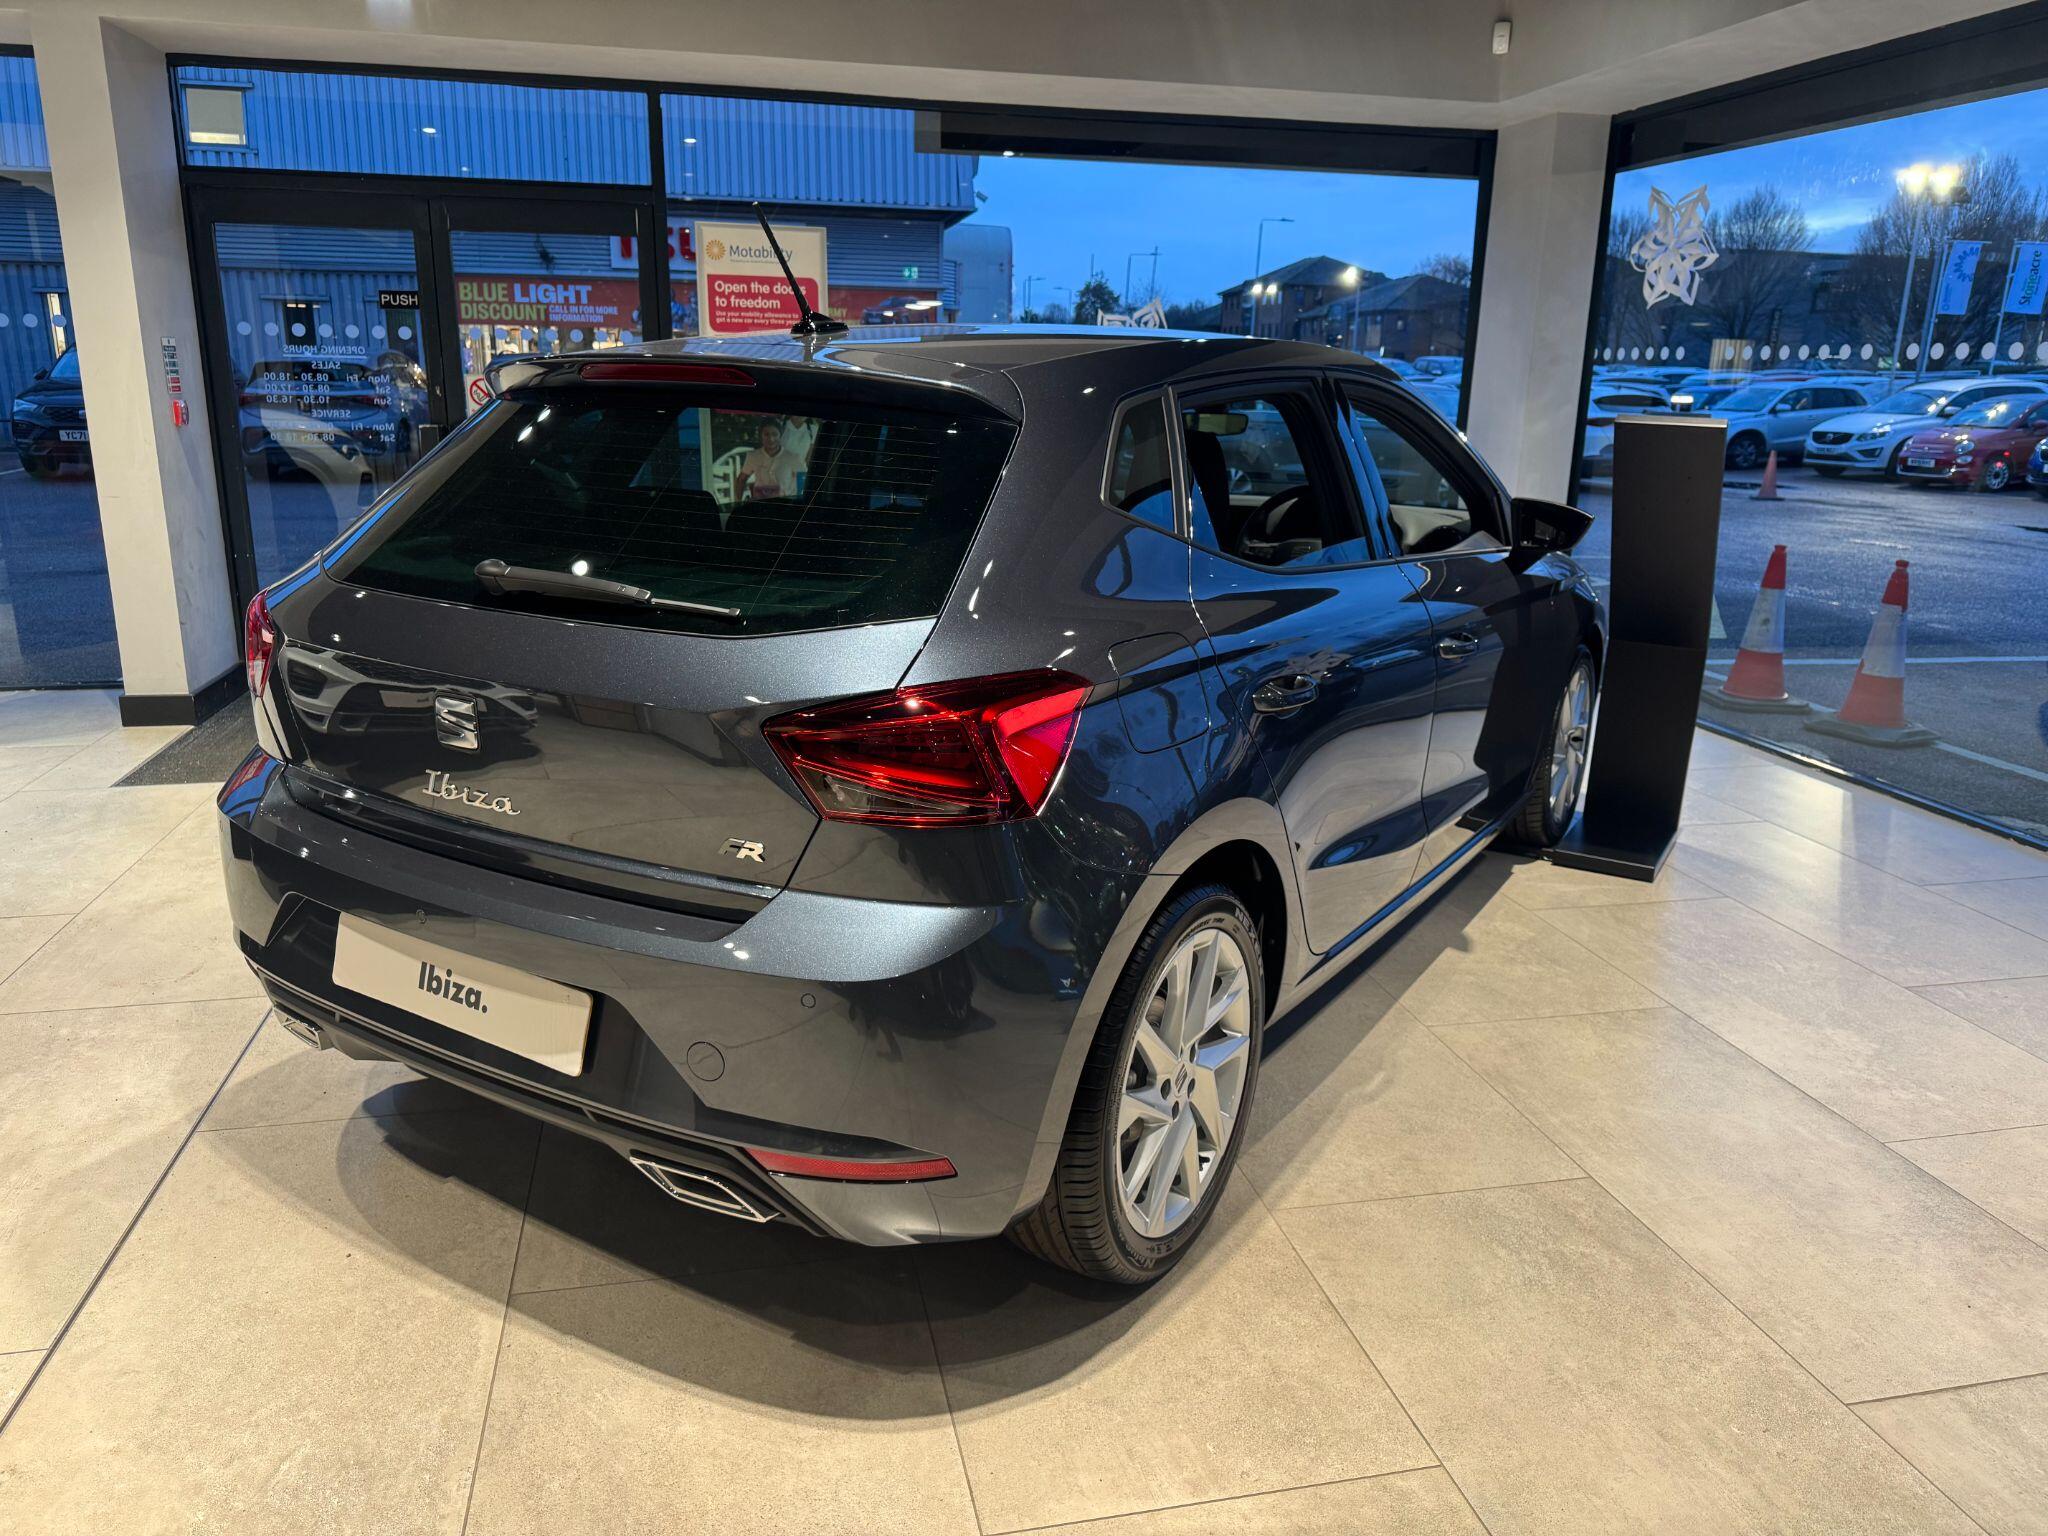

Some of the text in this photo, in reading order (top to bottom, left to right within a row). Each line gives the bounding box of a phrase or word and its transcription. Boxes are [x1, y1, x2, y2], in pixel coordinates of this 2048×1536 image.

[2018, 250, 2042, 306] Stoneacre
[458, 282, 593, 305] BLUE LIGHT
[714, 281, 806, 295] Open the doos
[381, 294, 419, 306] PUSH
[715, 295, 781, 309] to freedom
[460, 303, 547, 321] DISCOUNT
[549, 305, 618, 316] CALL IN FOR MORE
[549, 314, 604, 323] INFORMATION
[422, 768, 521, 815] Ibiza
[718, 837, 766, 863] FR
[418, 961, 488, 1014] Ibiza.
